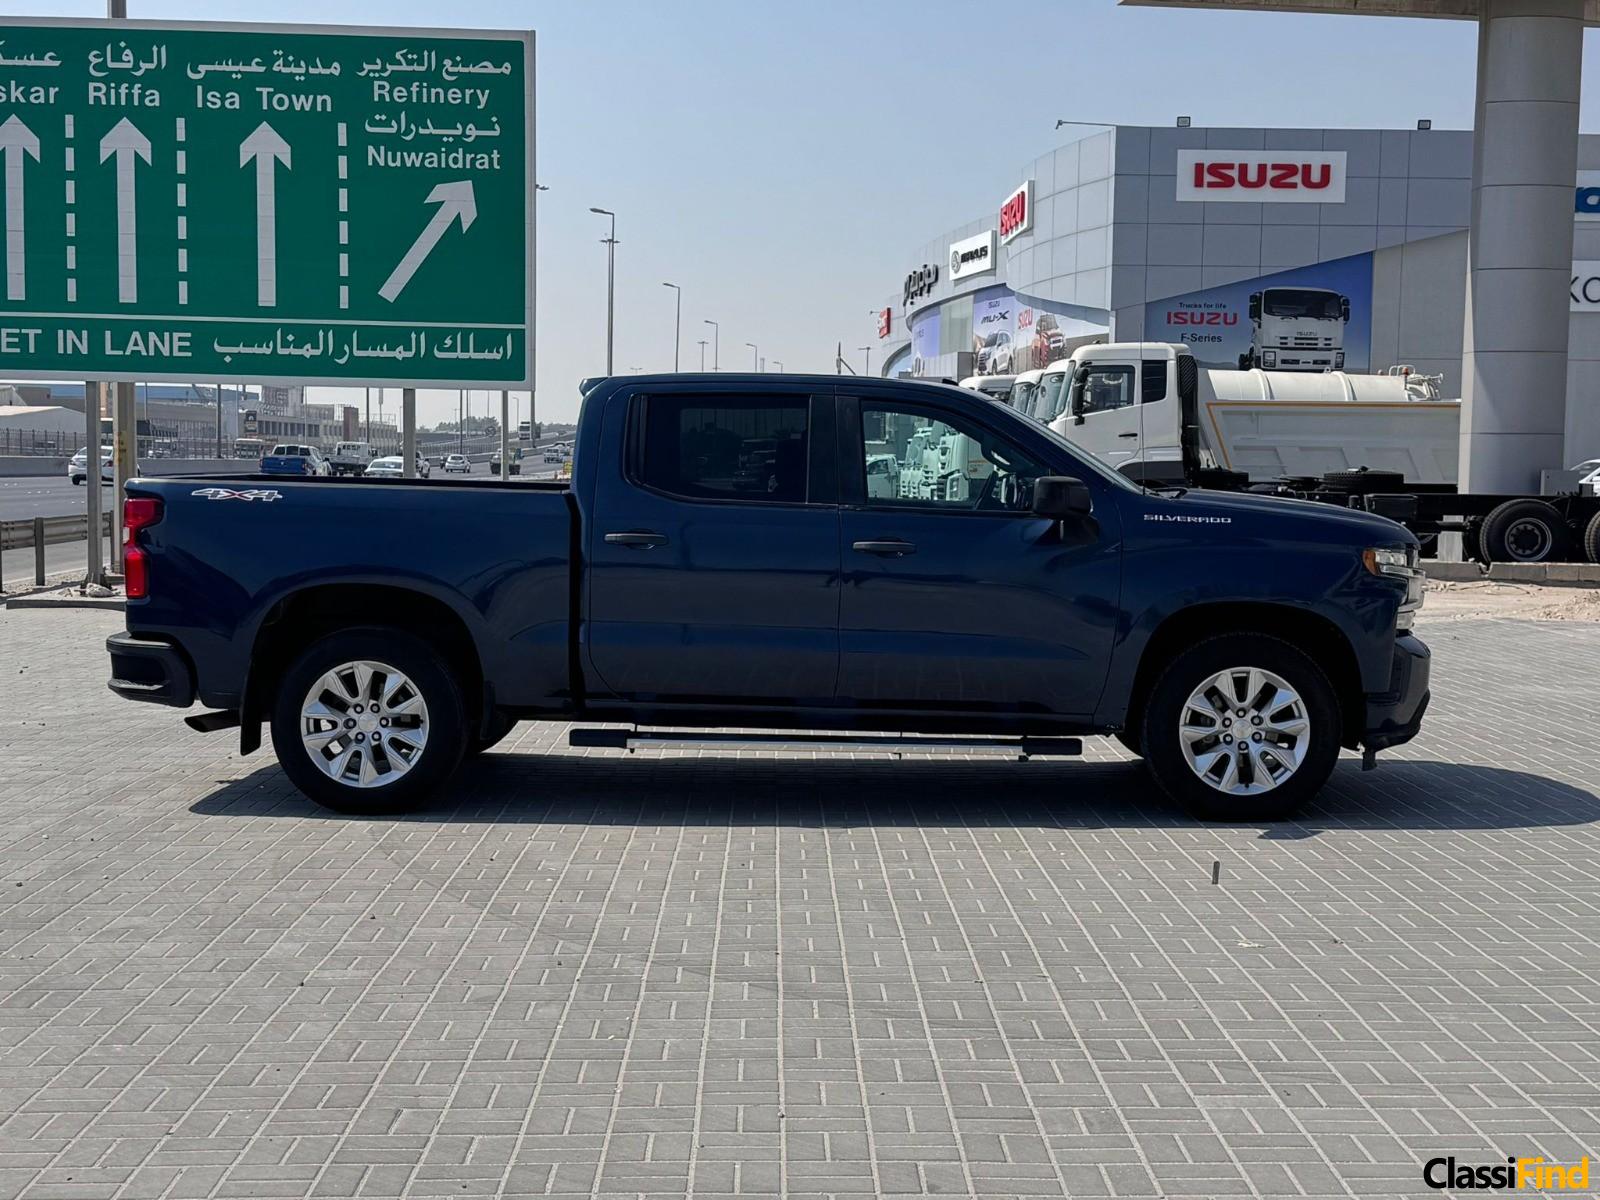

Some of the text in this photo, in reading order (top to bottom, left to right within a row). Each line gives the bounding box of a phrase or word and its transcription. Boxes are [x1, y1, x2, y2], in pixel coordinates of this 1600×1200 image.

[0, 40, 62, 67] عس
[88, 41, 167, 77] الرفاع
[186, 49, 341, 81] مدينة عيسى
[356, 48, 512, 81] مصنع التكرير
[88, 82, 160, 107] Riffa
[196, 85, 332, 112] Isa Town
[373, 80, 490, 109] Refinery
[364, 110, 501, 142] نويدرات
[367, 145, 501, 169] Nuwaidrat
[1194, 163, 1331, 189] ISUZU
[1167, 312, 1238, 326] ISUZU
[1, 328, 192, 357] ET IN LANE
[213, 327, 512, 365] اسلك المسار المناسب
[1180, 333, 1223, 343] F-Series
[1143, 514, 1232, 523] SILVERADO
